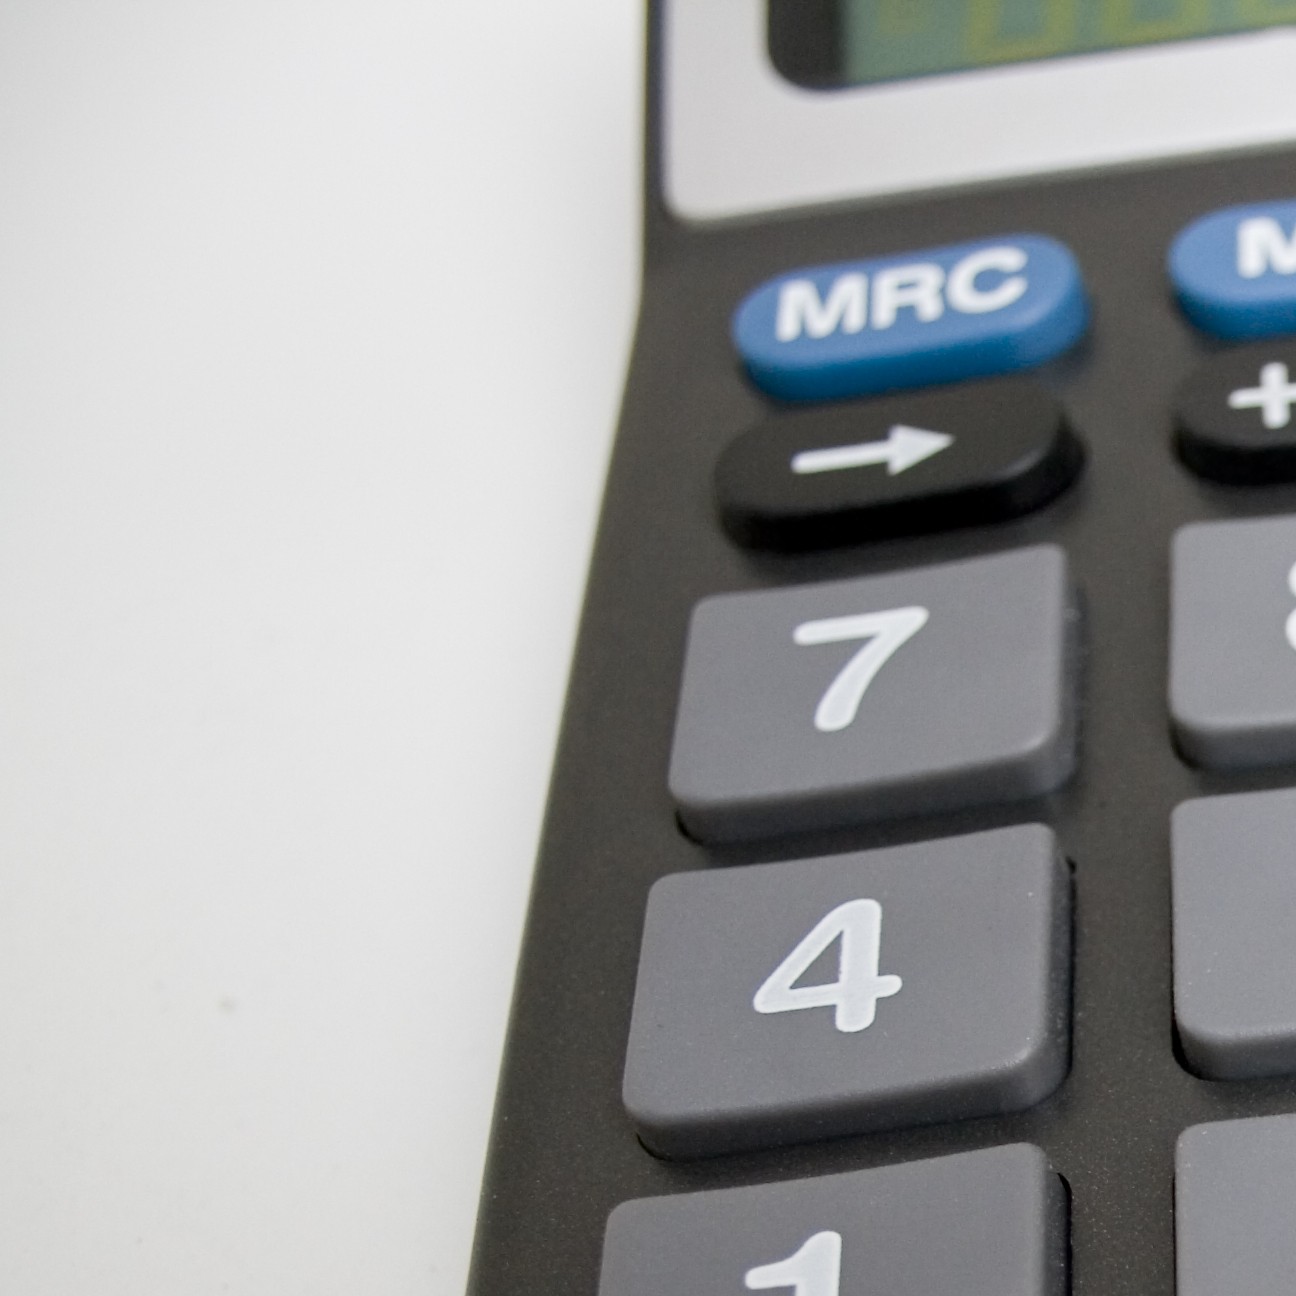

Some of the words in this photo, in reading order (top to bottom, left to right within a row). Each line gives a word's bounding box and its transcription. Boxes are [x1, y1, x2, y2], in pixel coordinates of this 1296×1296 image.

[776, 247, 1025, 341] MRC
[794, 607, 928, 731] 7
[754, 899, 902, 1032] 4
